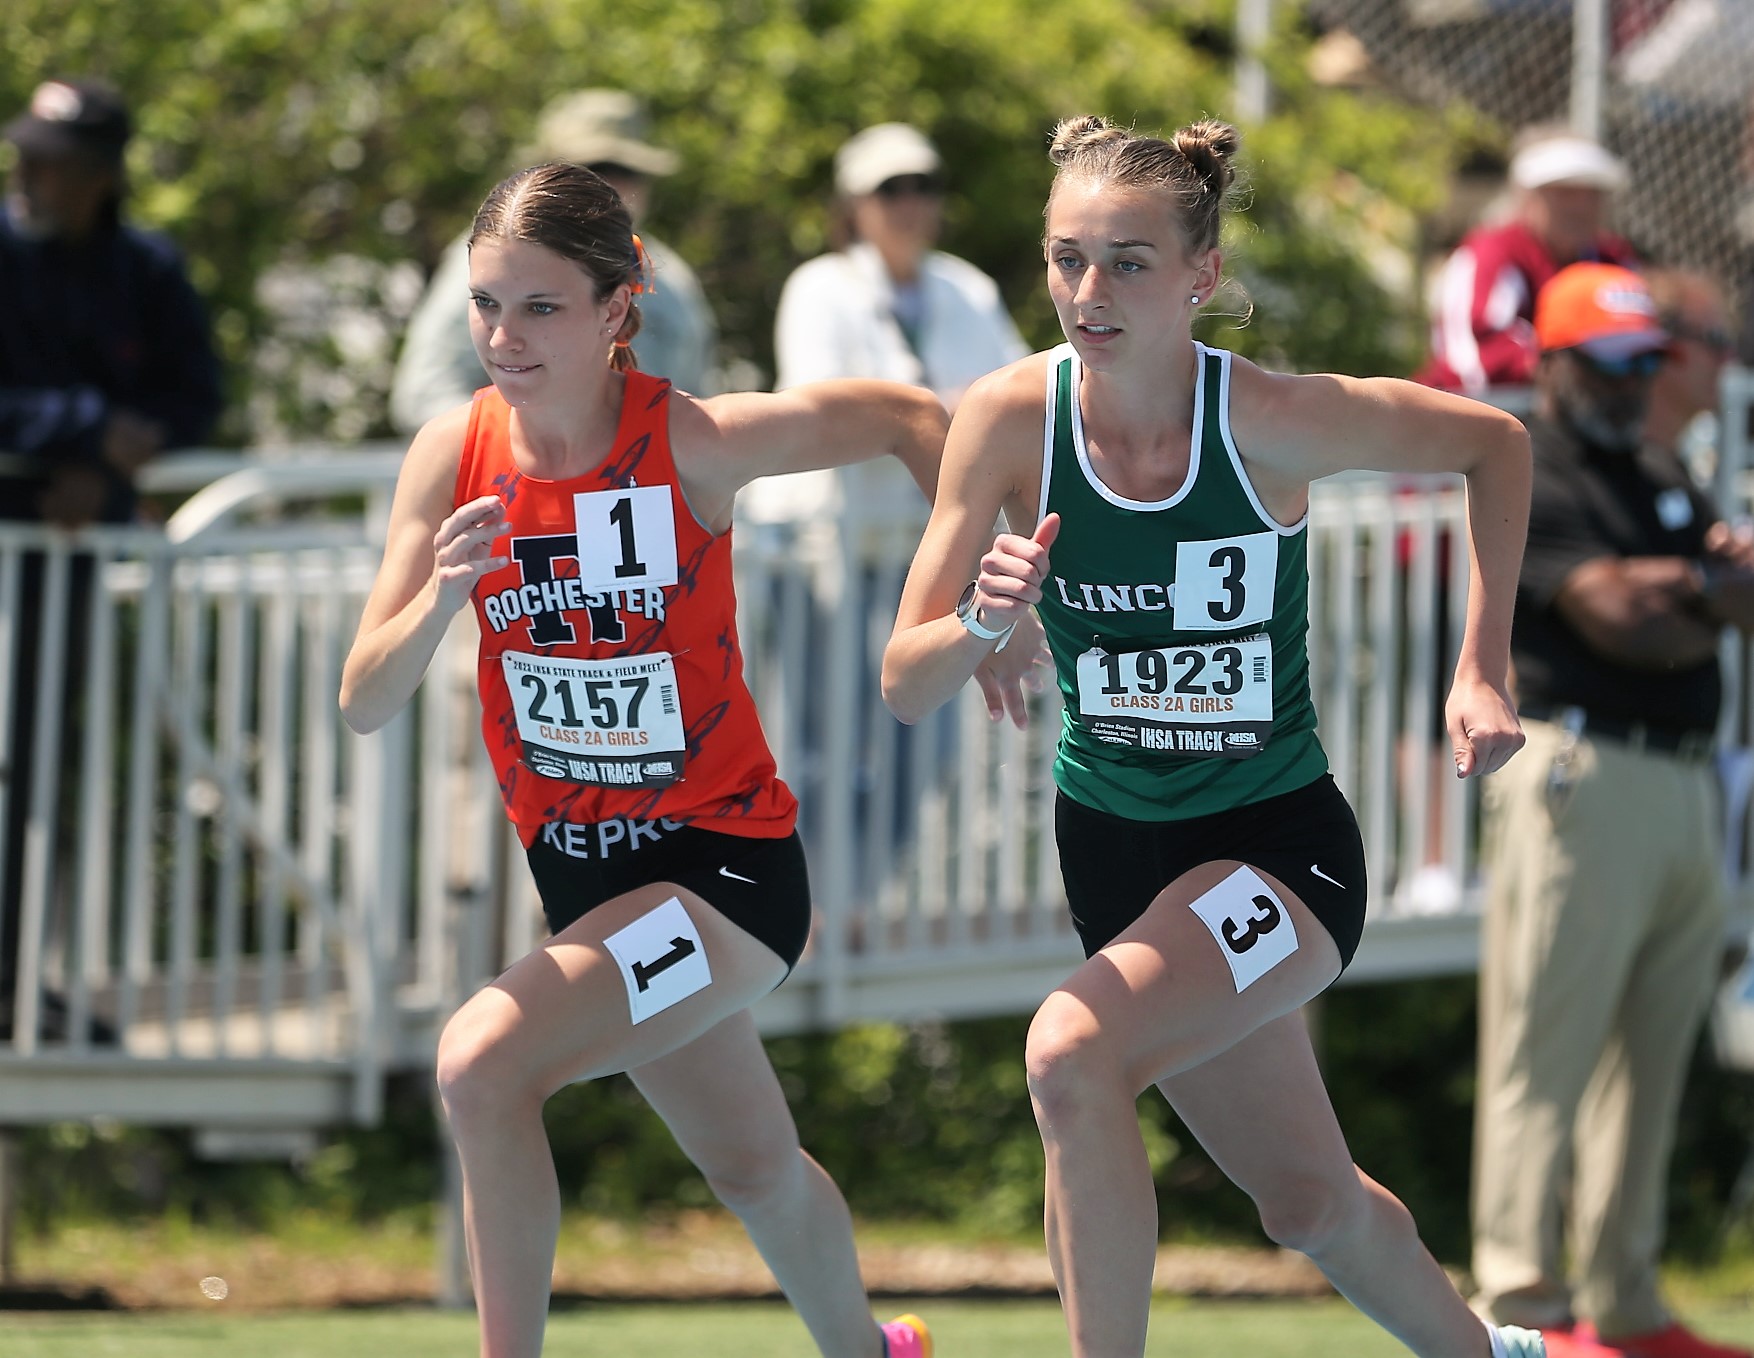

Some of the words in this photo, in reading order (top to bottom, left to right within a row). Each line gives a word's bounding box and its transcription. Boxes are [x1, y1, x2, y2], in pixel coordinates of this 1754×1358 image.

[609, 497, 647, 579] 1
[484, 577, 666, 633] ROCHESTER
[1207, 545, 1247, 622] 3
[553, 667, 575, 678] STATE
[578, 669, 603, 679] TRACK
[607, 670, 613, 678] &
[615, 666, 638, 677] FIELD
[640, 662, 660, 674] MEET
[1099, 646, 1243, 696] 1923
[521, 674, 650, 730] 2157
[1110, 695, 1160, 710] CLASS
[1164, 697, 1184, 712] 2A
[1189, 697, 1234, 713] GIRLS
[540, 725, 580, 745] CLASS
[585, 731, 603, 746] 2A
[608, 731, 648, 746] GIRLS
[1141, 727, 1175, 750] IHSA
[1176, 729, 1223, 752] TRACK
[568, 759, 600, 782] IHSA
[597, 762, 643, 784] TRACK
[1221, 894, 1281, 954] 3
[631, 936, 697, 994] 1
